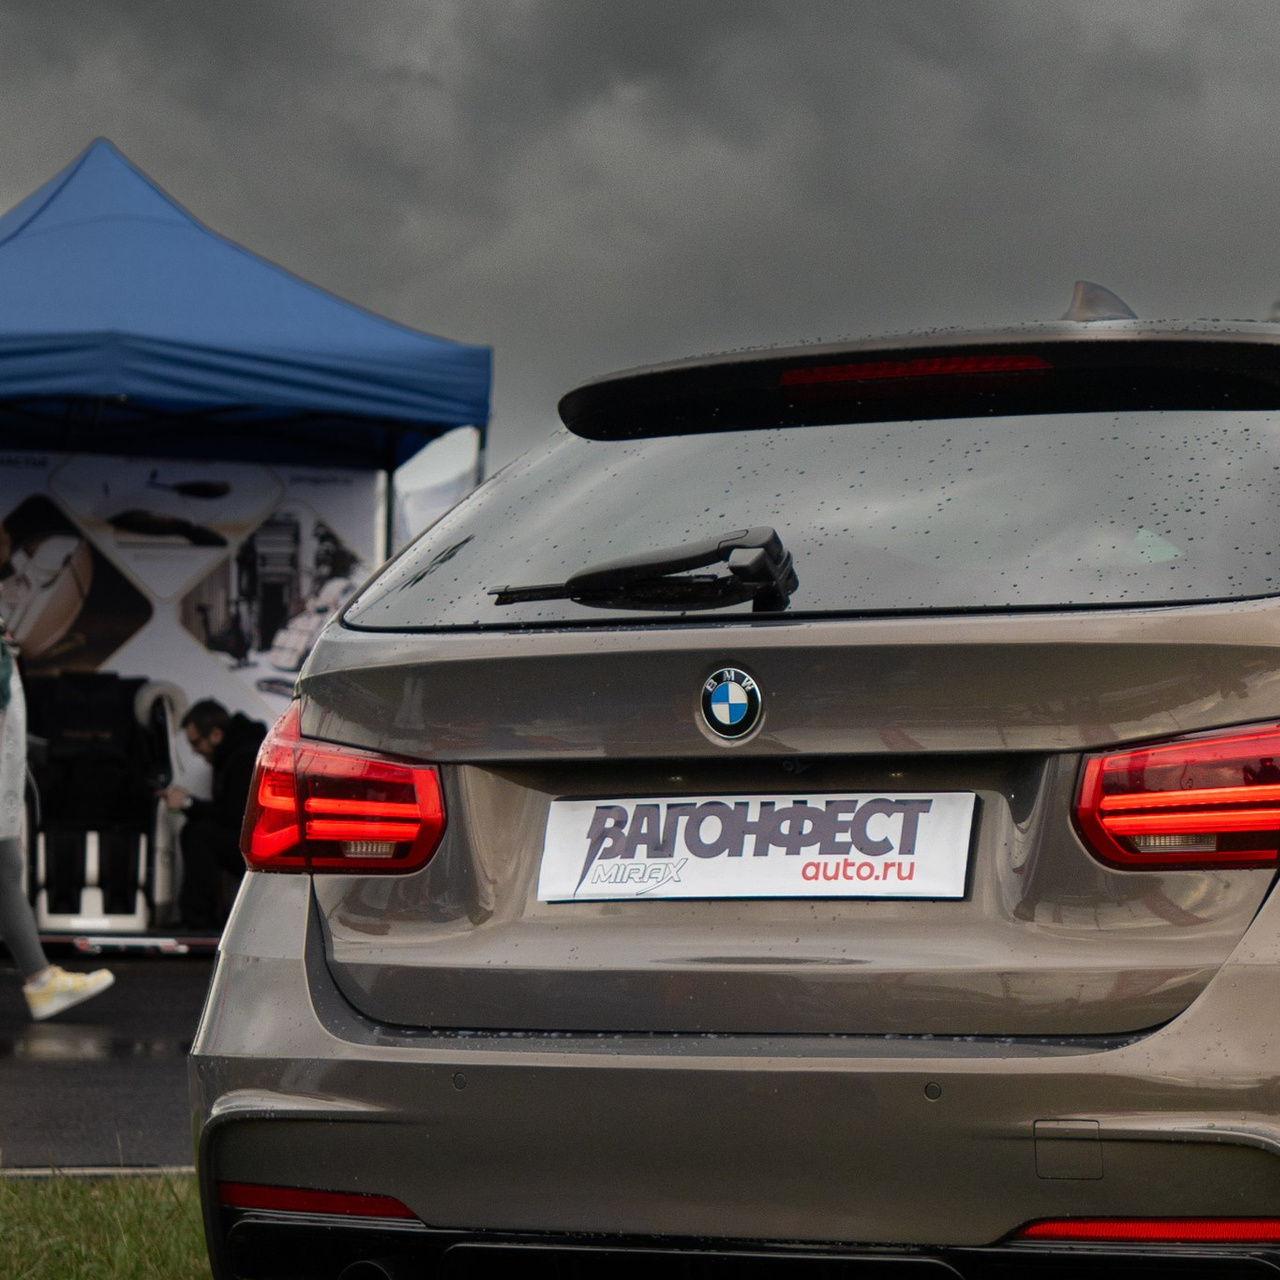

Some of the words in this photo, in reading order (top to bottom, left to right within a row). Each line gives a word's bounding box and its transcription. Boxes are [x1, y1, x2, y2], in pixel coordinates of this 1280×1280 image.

[704, 670, 755, 693] BMW
[574, 798, 933, 880] ВАГОНФЕСТ
[591, 858, 689, 896] MIRAX
[801, 858, 915, 881] auto.ru
